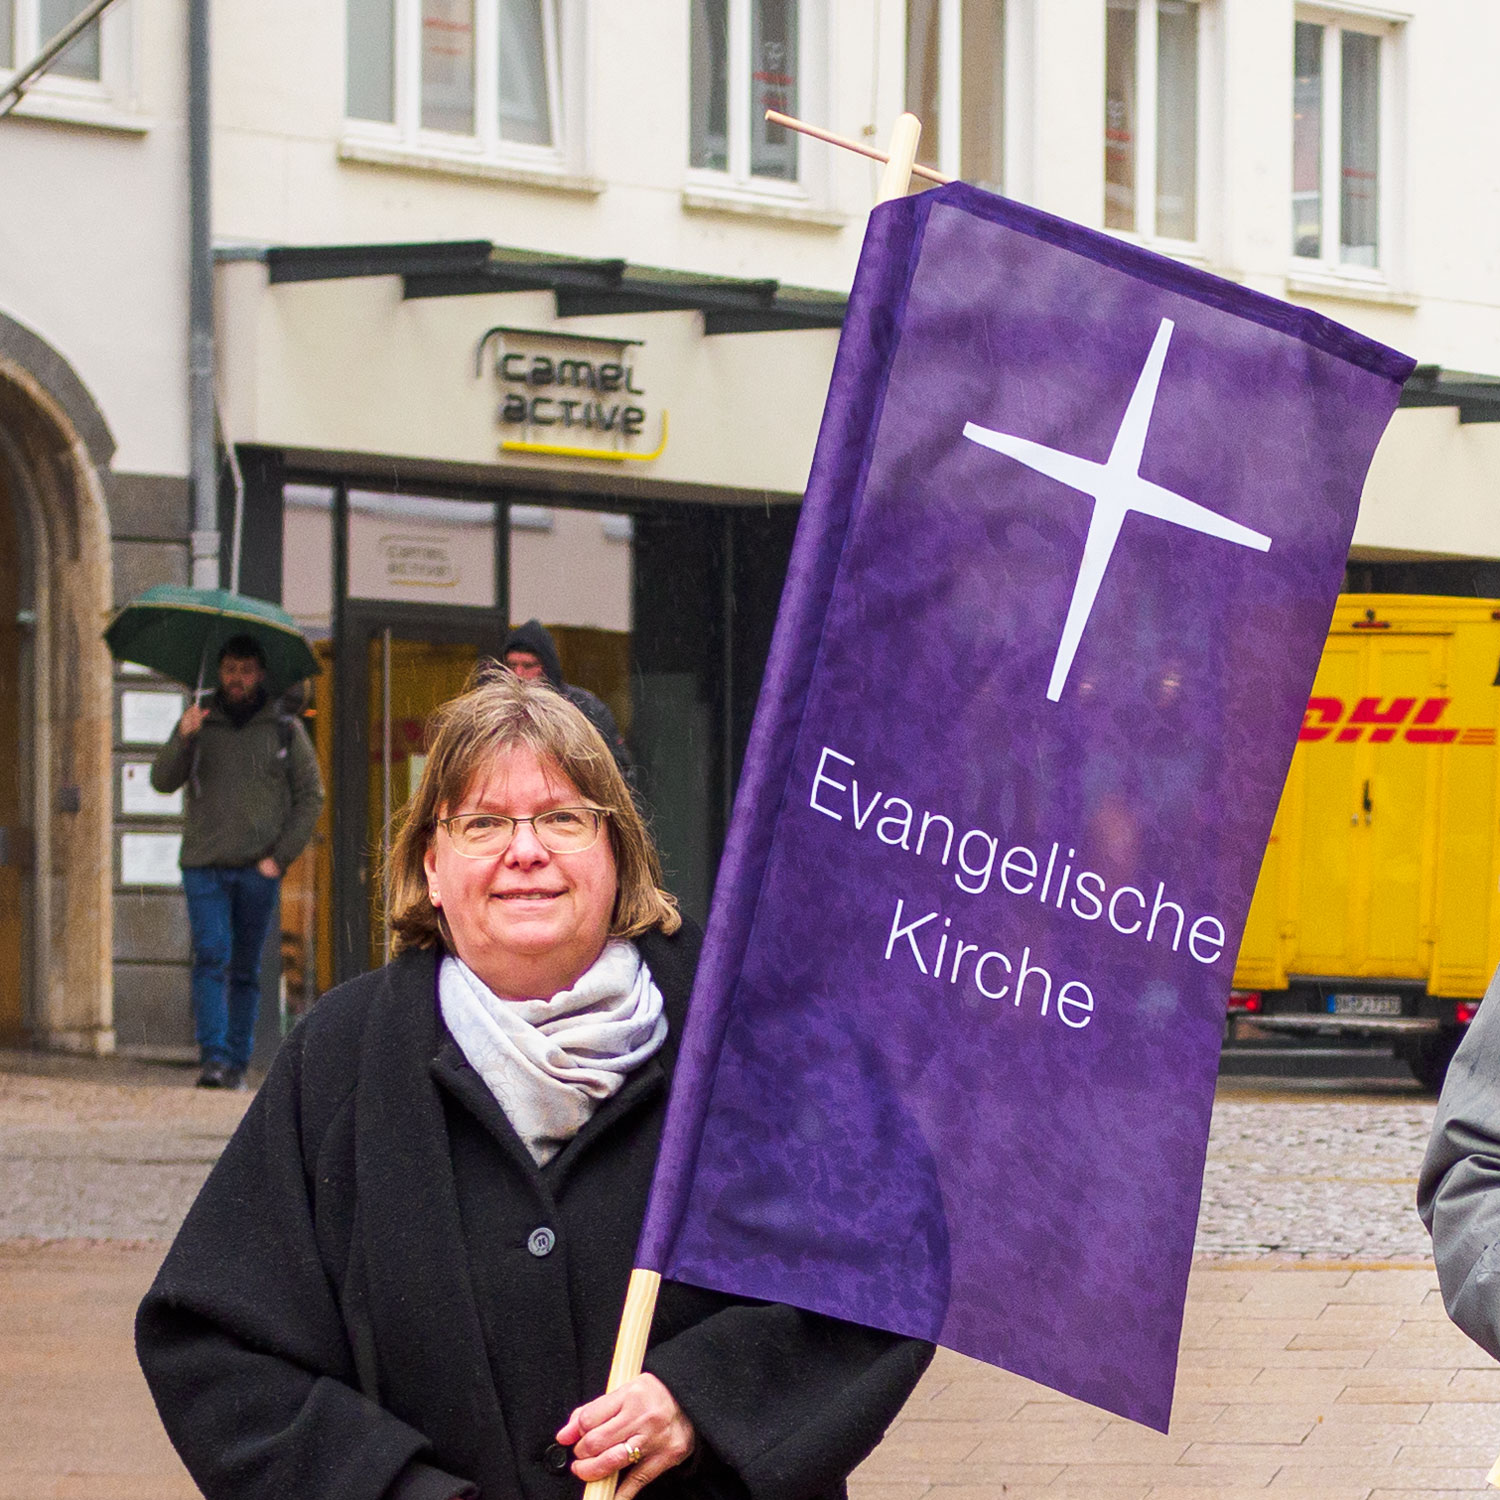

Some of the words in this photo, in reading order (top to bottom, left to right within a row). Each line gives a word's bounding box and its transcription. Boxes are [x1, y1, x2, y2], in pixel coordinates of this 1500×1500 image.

[1298, 696, 1461, 744] DHL
[809, 746, 1226, 964] Evangelische
[884, 898, 1095, 1029] Kirche
